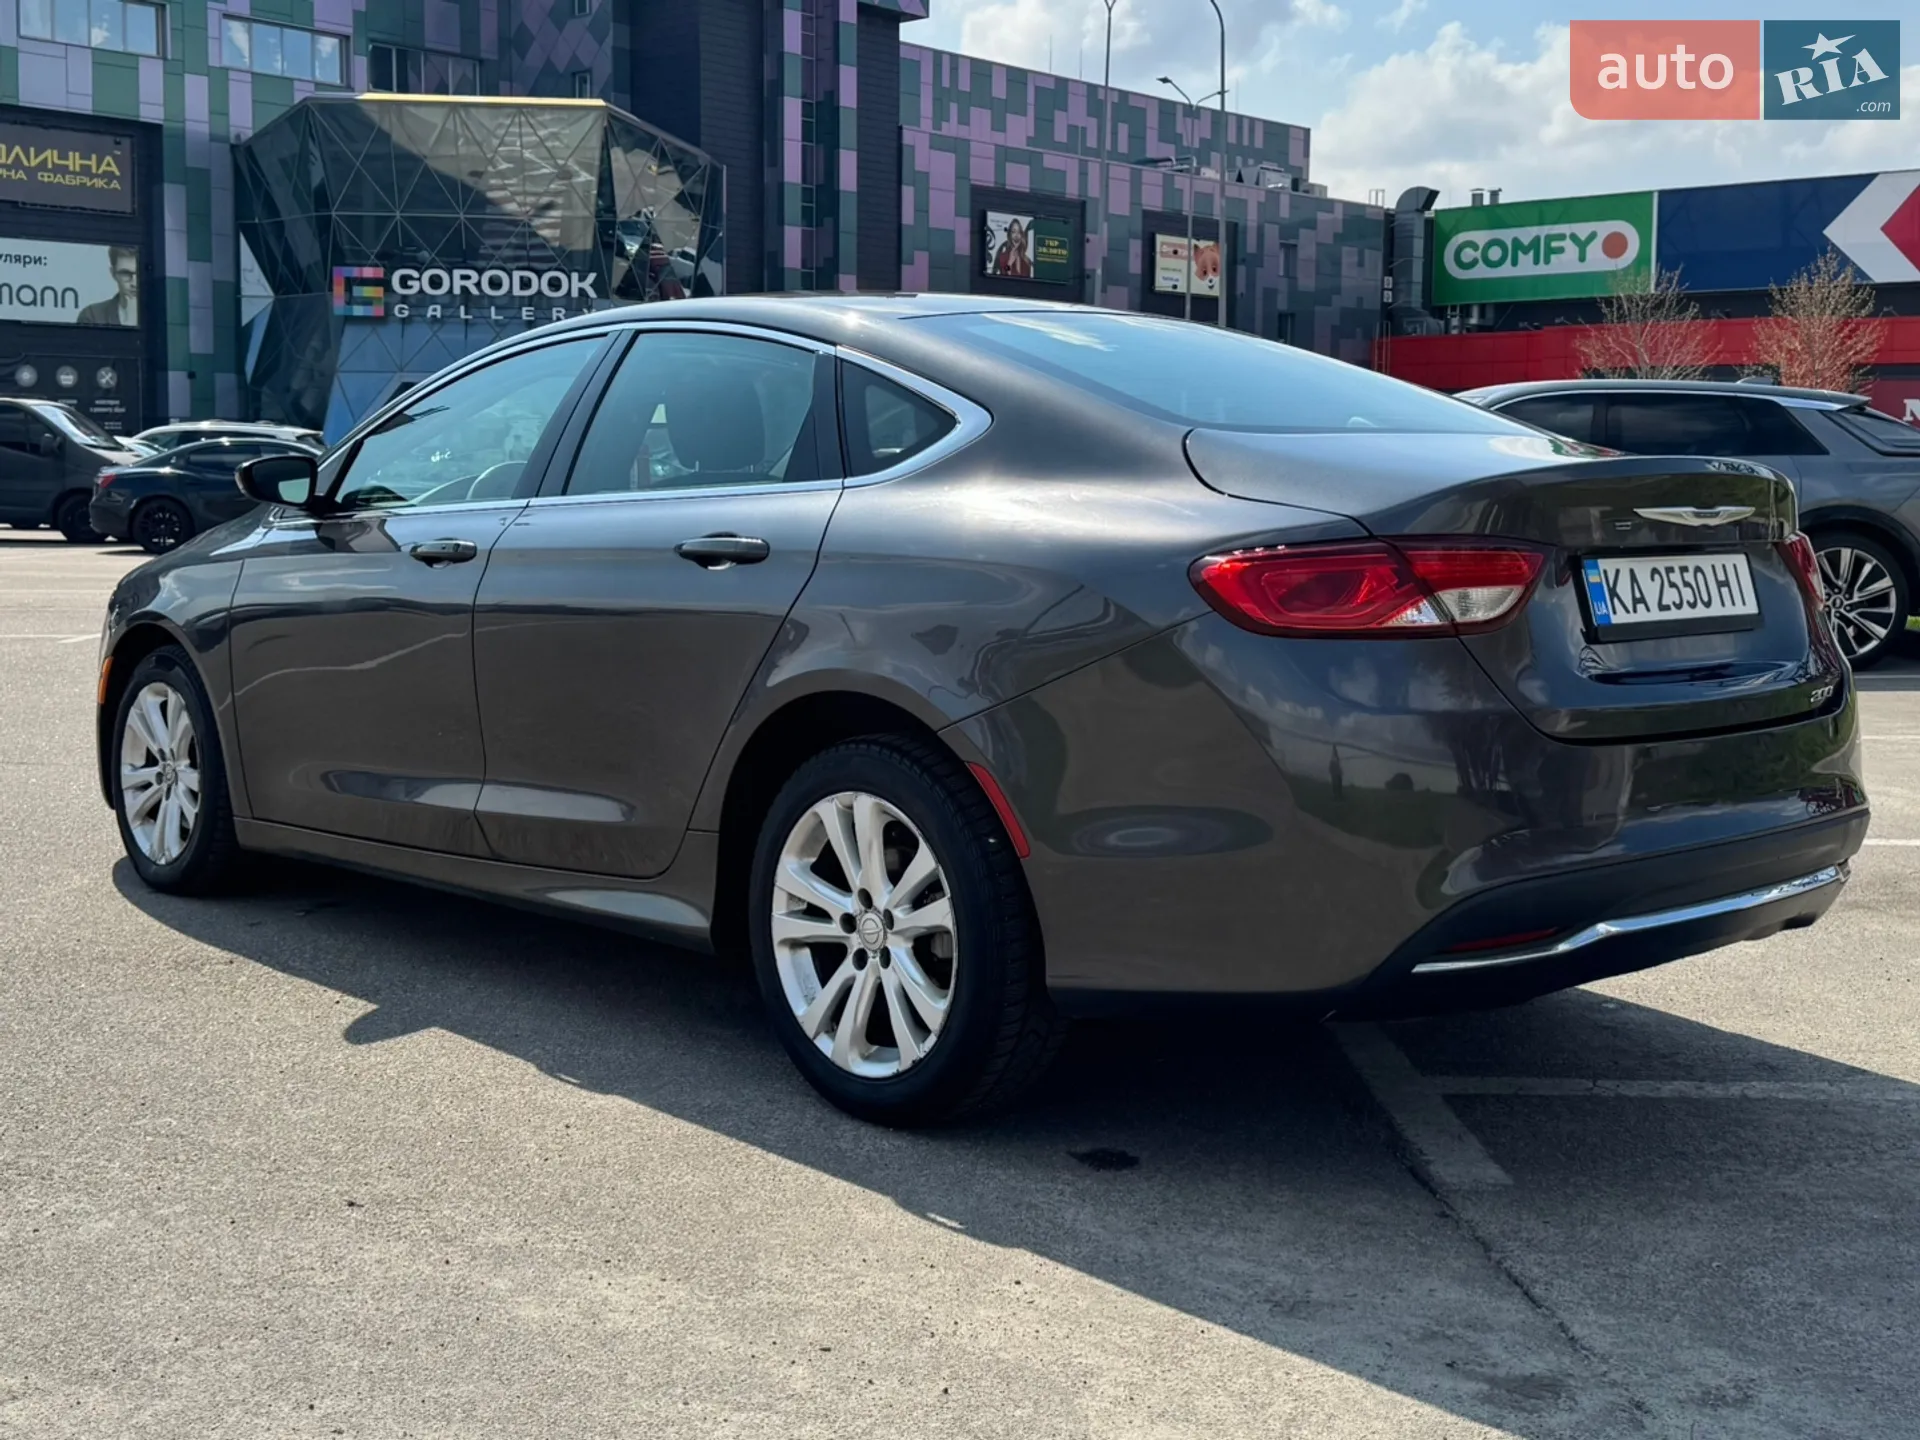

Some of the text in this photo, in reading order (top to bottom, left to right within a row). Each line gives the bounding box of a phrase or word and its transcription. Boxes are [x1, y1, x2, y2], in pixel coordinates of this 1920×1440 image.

[37, 171, 122, 190] ФАБРИКА
[1453, 230, 1599, 270] COMFY
[391, 268, 598, 298] GORODOK
[1603, 562, 1747, 616] KA 2550 HI
